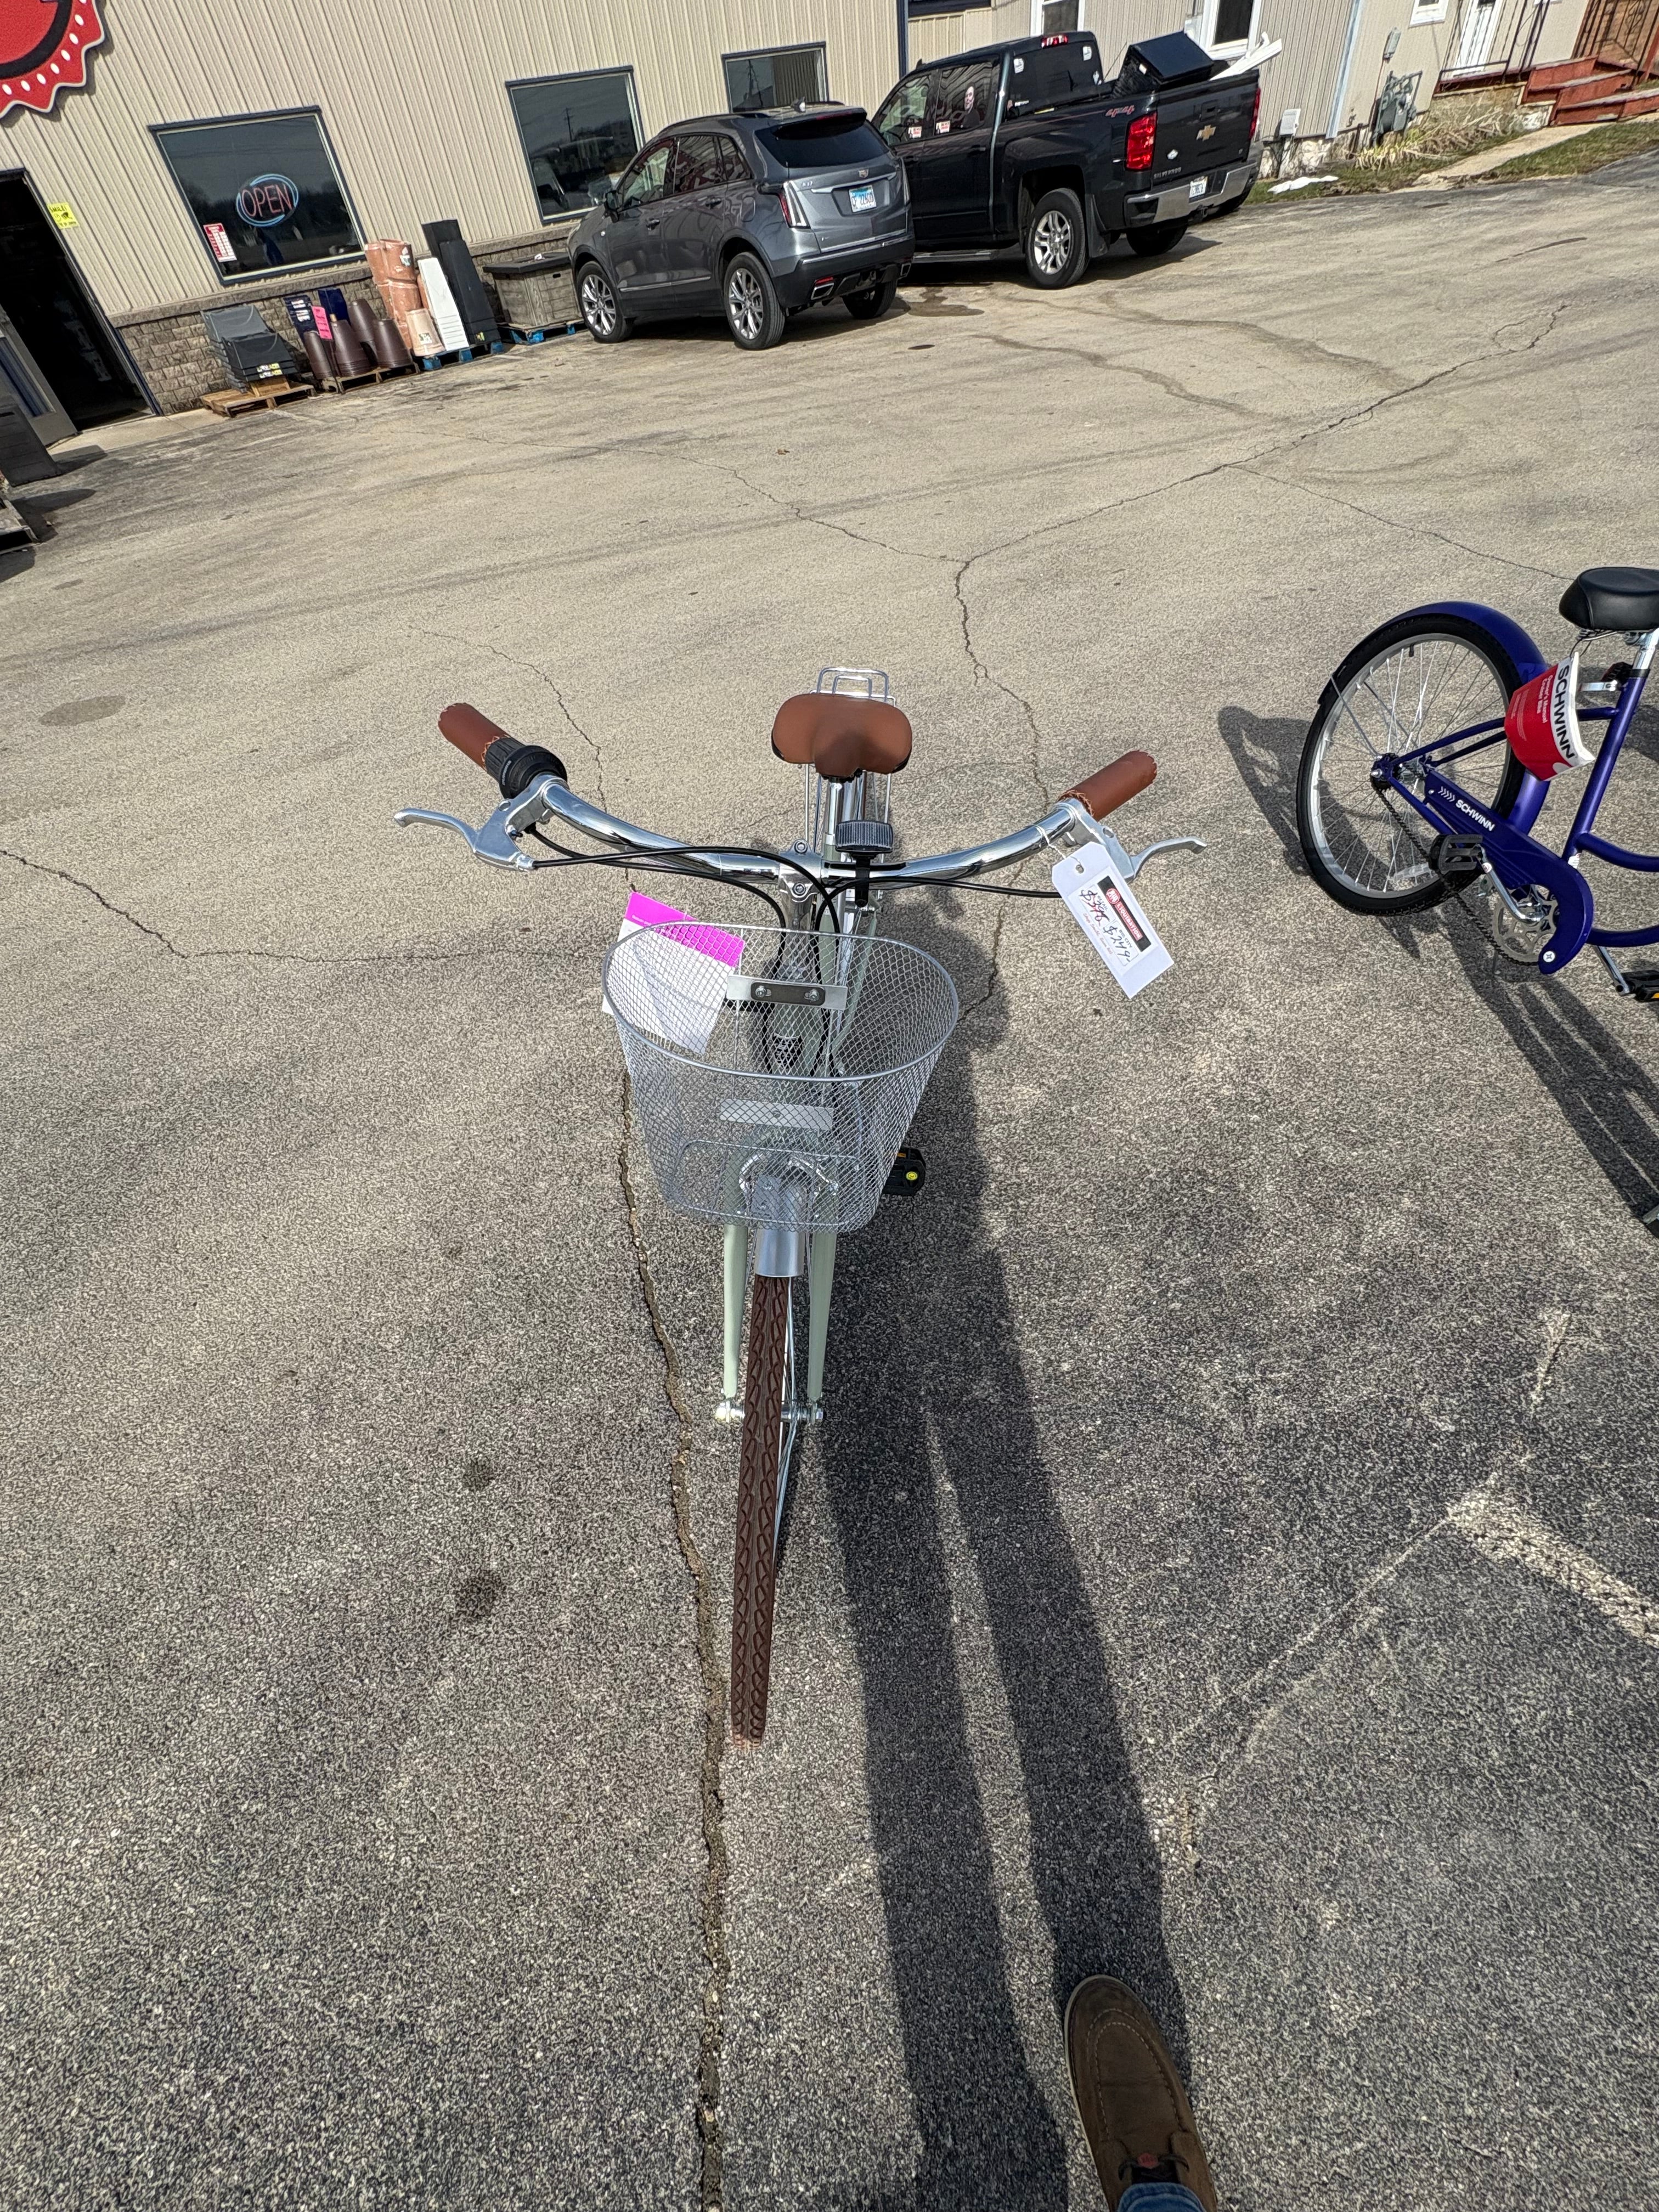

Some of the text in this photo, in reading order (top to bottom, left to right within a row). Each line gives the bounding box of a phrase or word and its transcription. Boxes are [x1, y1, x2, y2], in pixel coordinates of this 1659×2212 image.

[241, 183, 292, 217] OPEN
[1554, 665, 1576, 759] SCHWINN
[1455, 799, 1496, 832] SCHWINN
[1116, 904, 1141, 939] LIQUIDATION
[1124, 938, 1132, 949] CITY
